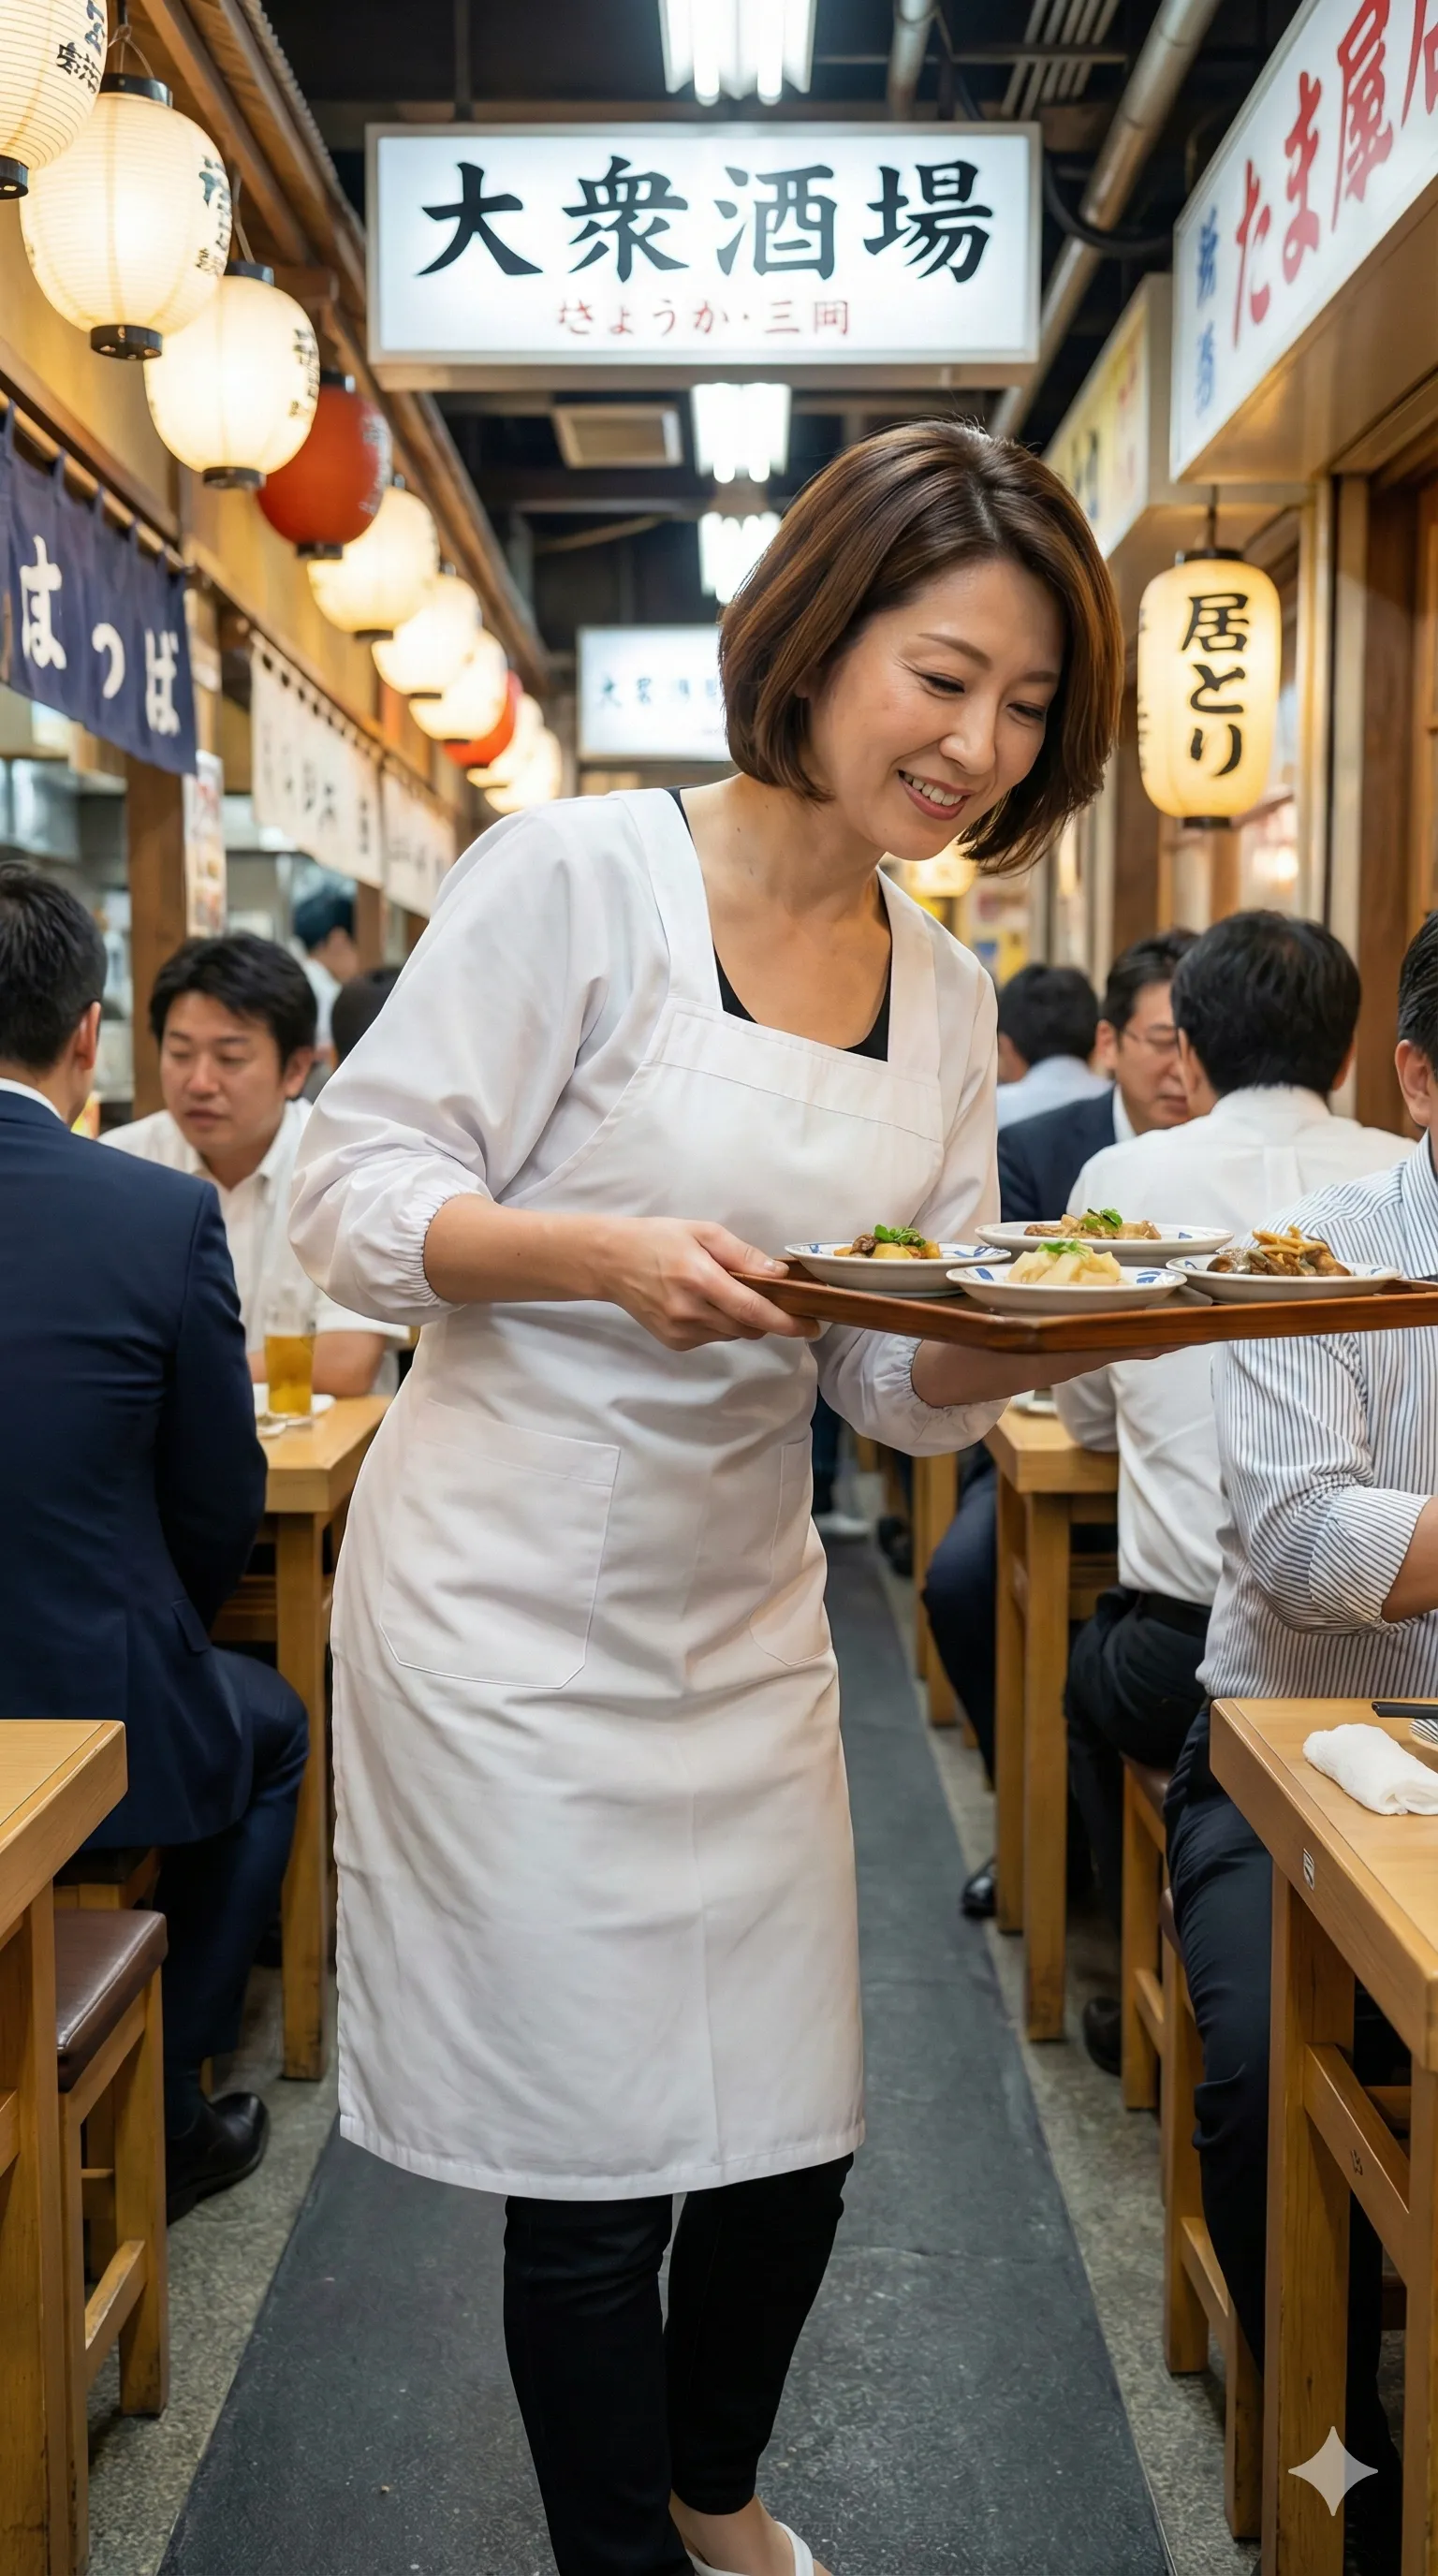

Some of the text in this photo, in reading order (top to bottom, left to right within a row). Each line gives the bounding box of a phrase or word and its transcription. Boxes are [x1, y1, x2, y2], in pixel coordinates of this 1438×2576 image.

[415, 154, 994, 283] 大衆酒場
[1181, 592, 1250, 778] 居とり
